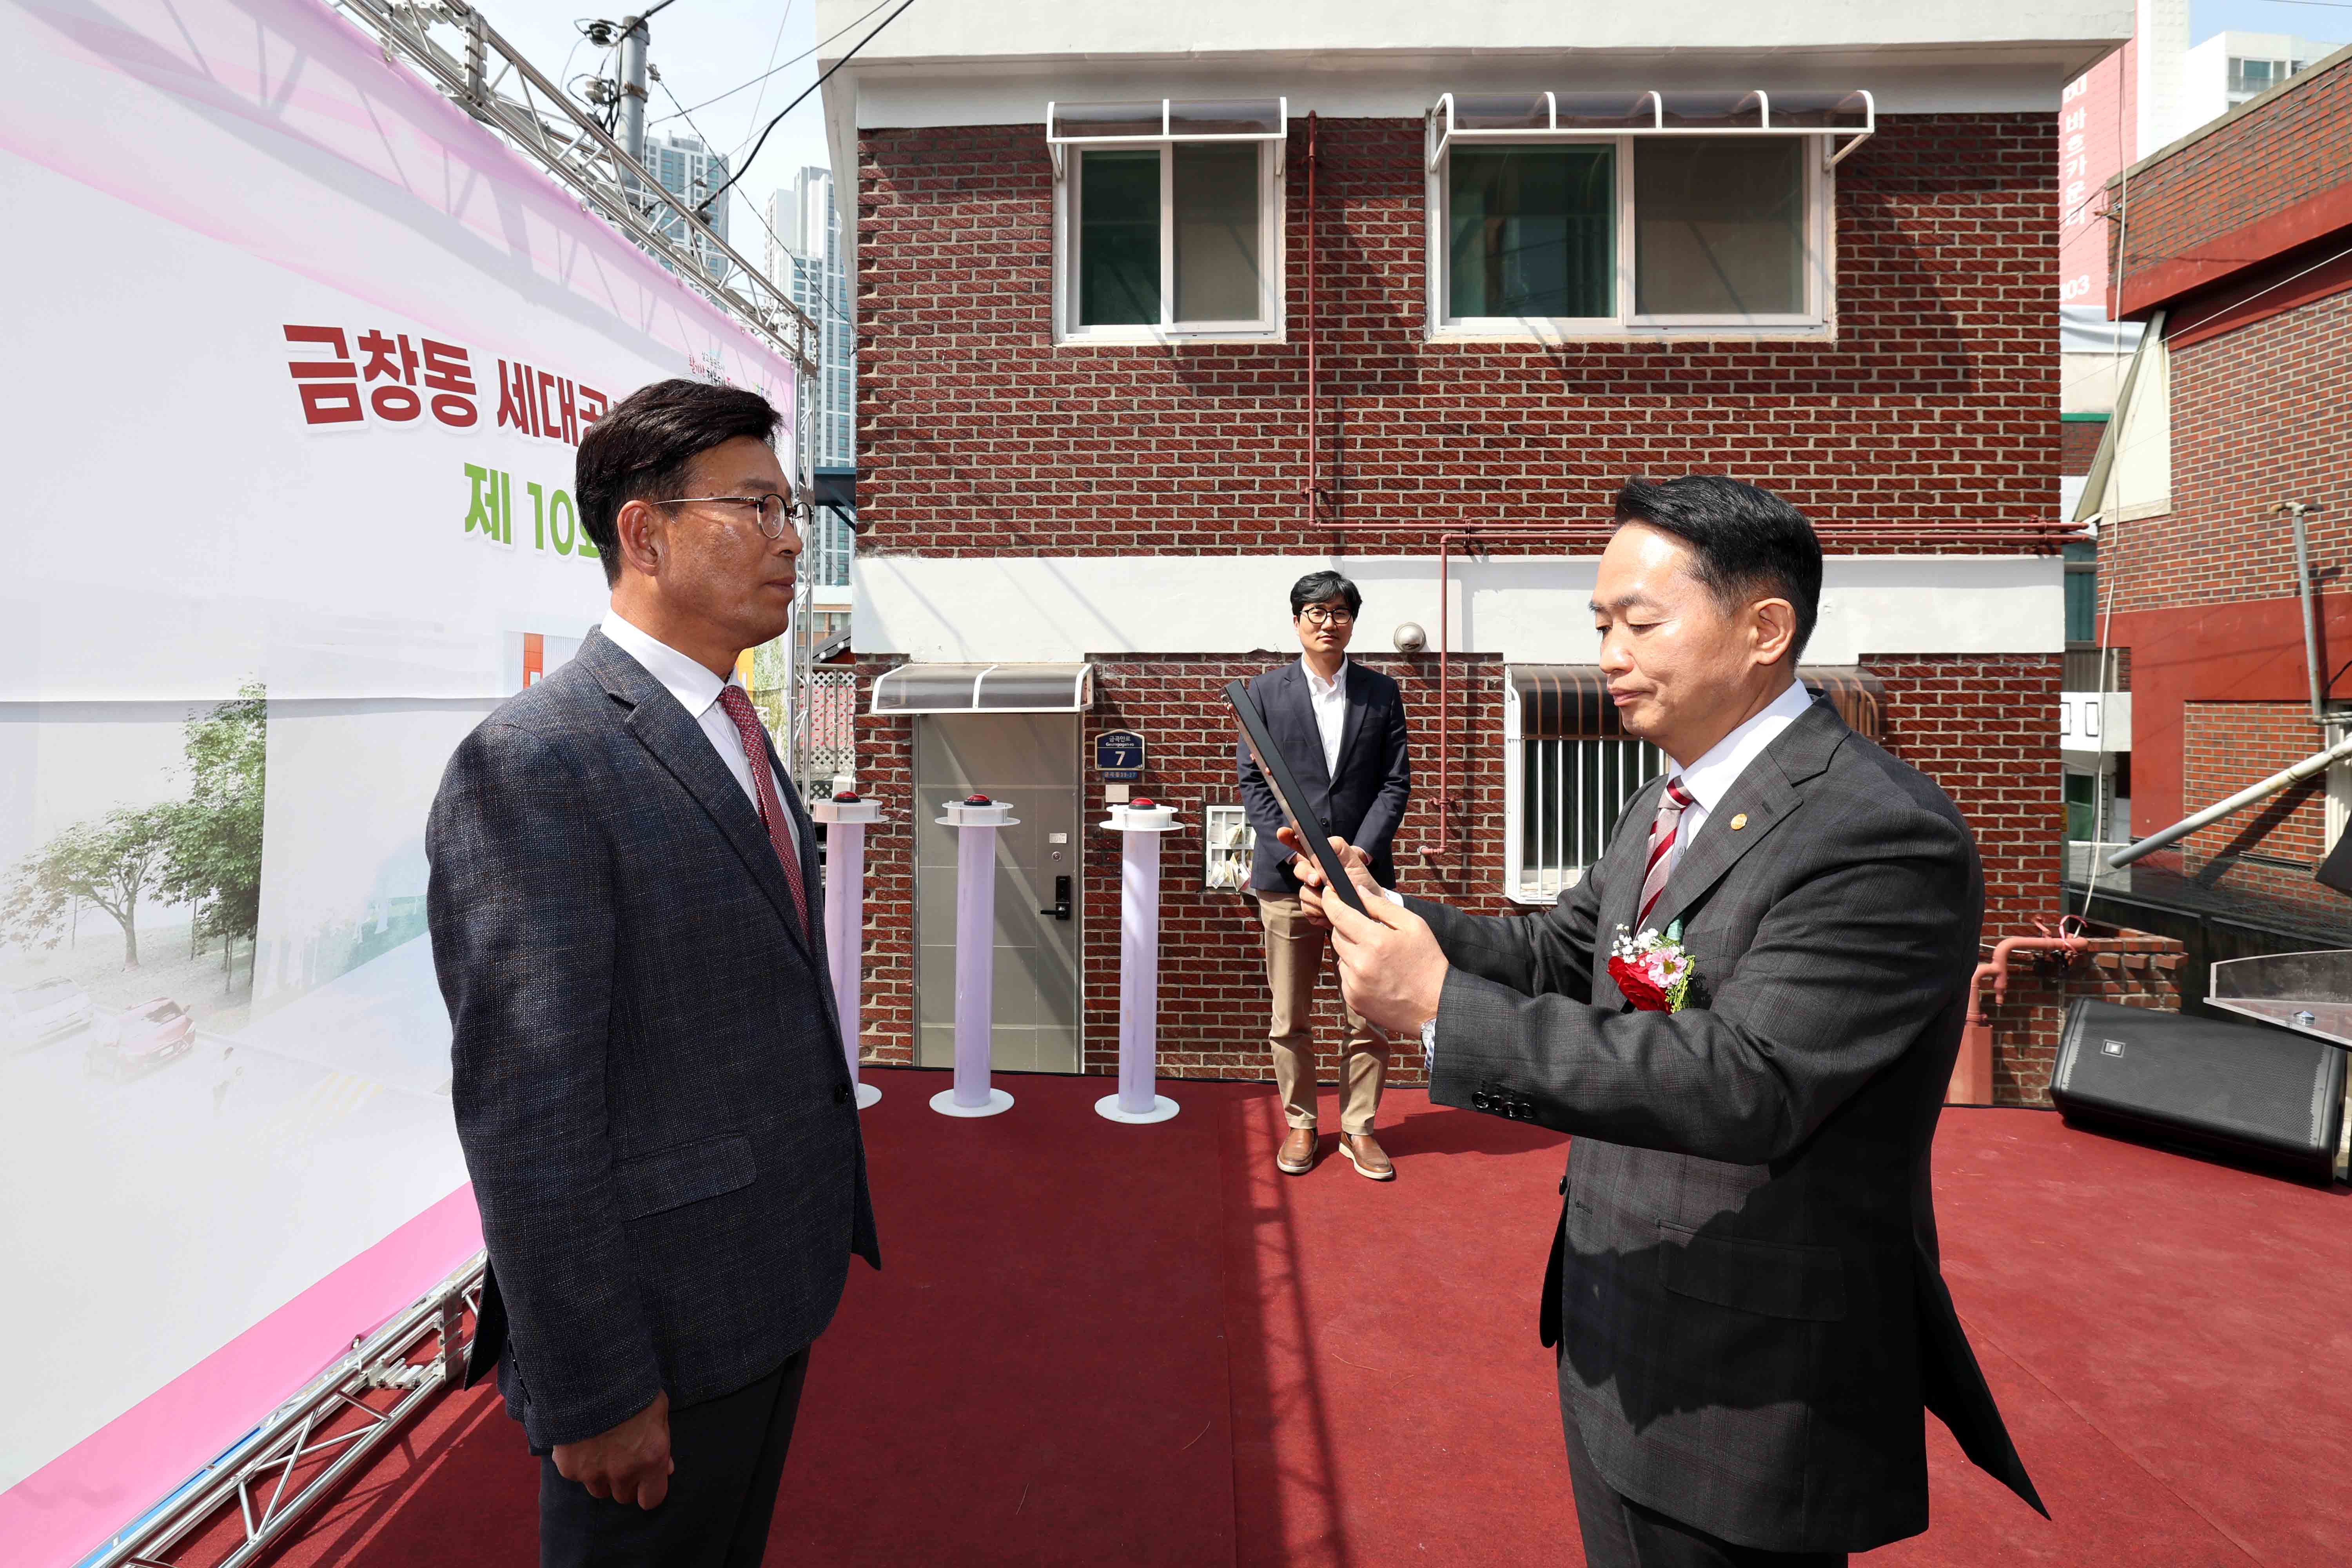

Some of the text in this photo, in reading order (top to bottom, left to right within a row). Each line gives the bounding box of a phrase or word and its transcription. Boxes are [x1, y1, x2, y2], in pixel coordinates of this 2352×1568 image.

[283, 325, 619, 447] 금창동 세대공
[465, 463, 511, 544] 제
[1115, 751, 1125, 765] 7
